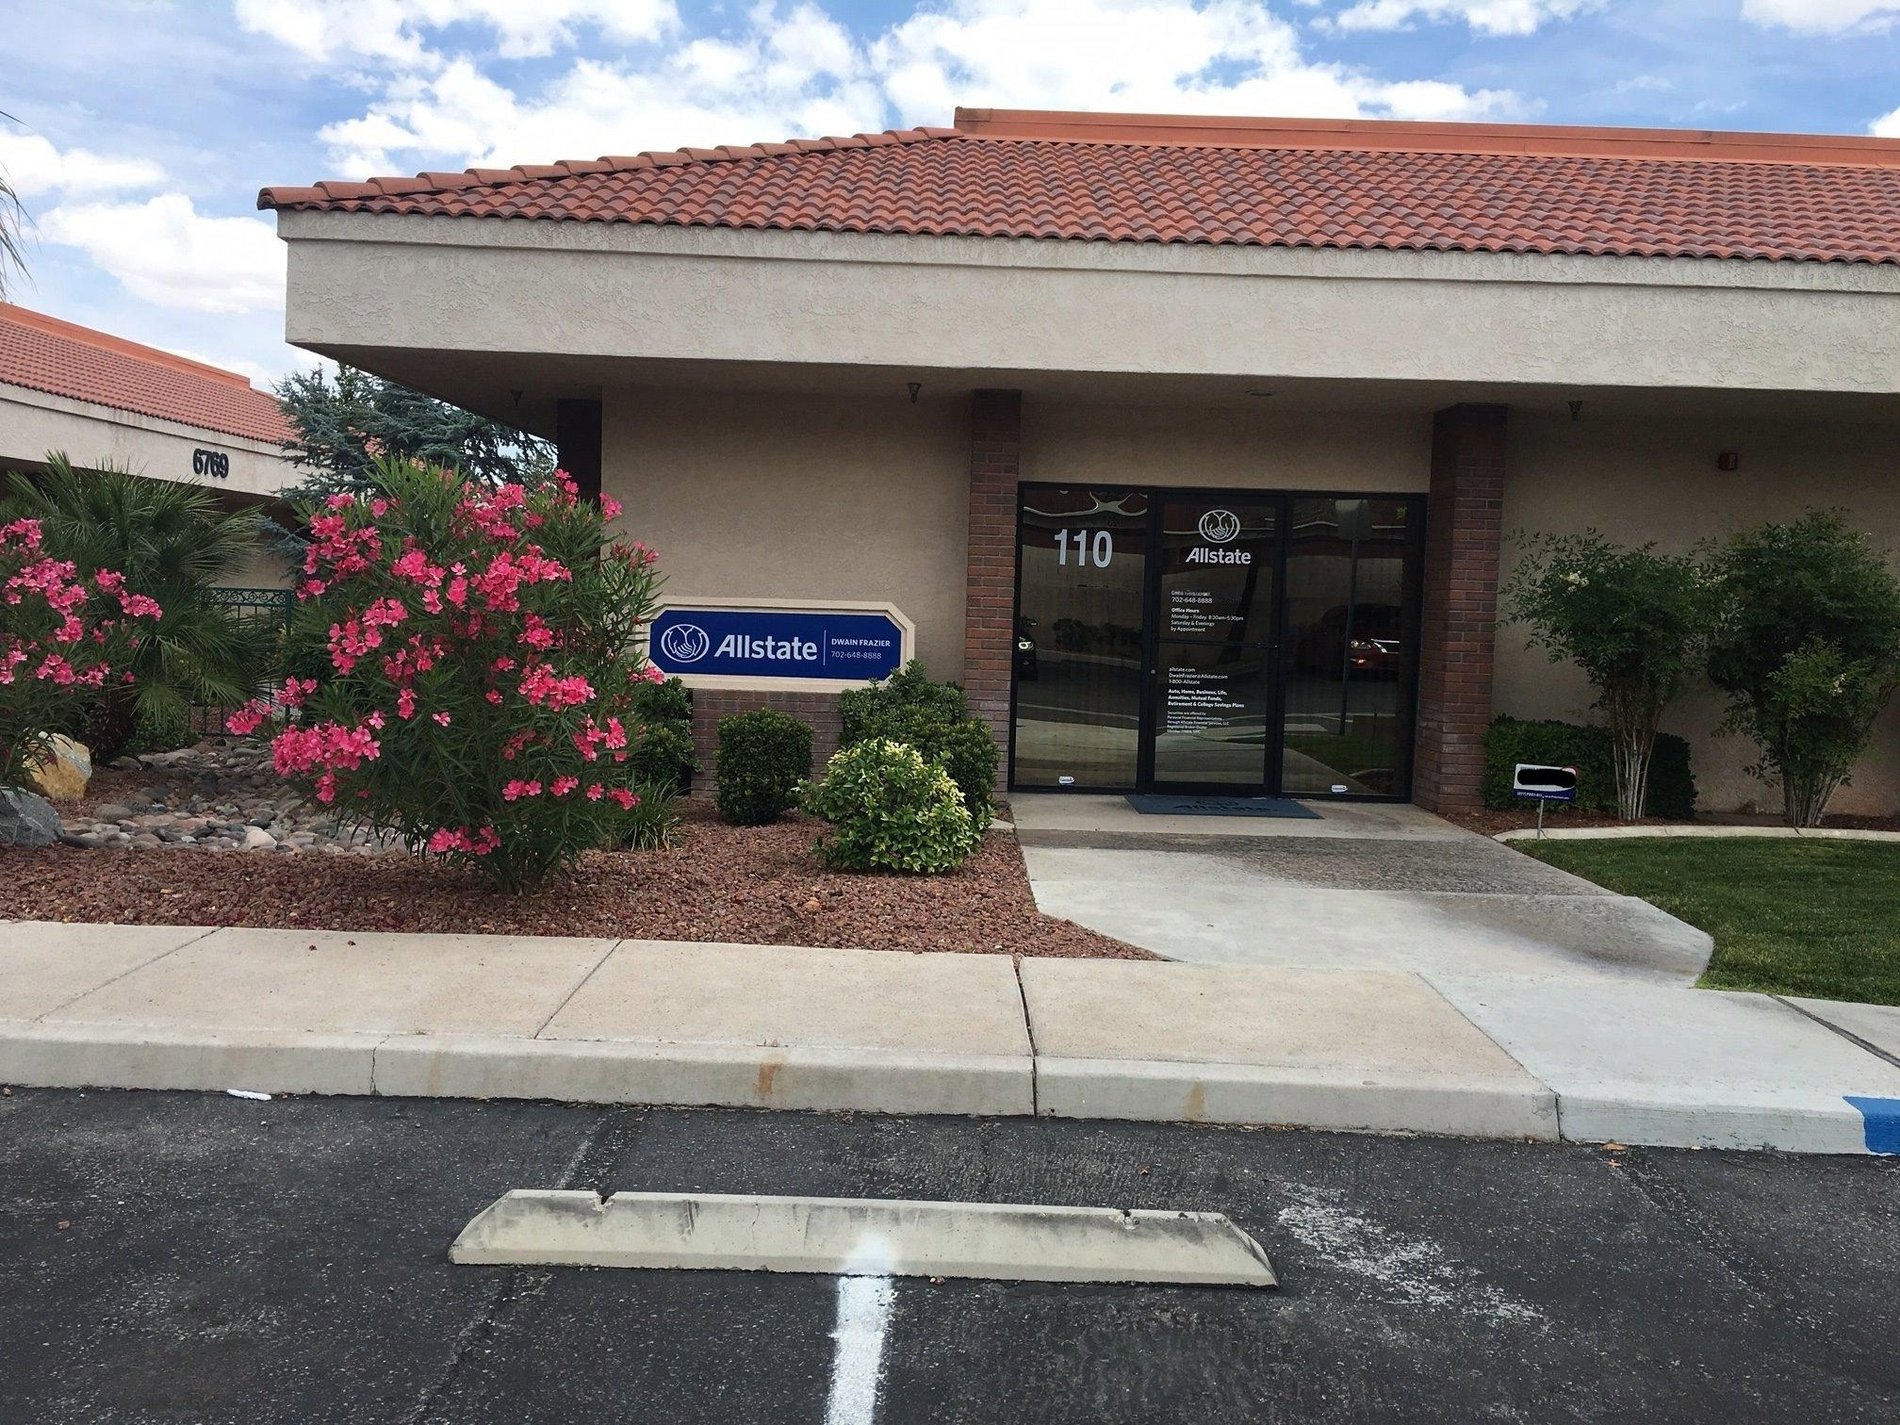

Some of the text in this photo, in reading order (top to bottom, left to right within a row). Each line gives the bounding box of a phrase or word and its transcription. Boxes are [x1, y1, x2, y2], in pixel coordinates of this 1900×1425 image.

[193, 448, 229, 478] 6769
[1054, 529, 1113, 568] 110
[1185, 547, 1251, 565] Allstate
[1171, 596, 1213, 604] 702-648-8888
[714, 635, 818, 661] Allstate
[831, 638, 891, 647] DWAIN FRAZIER
[831, 651, 882, 660] 702-648-8888
